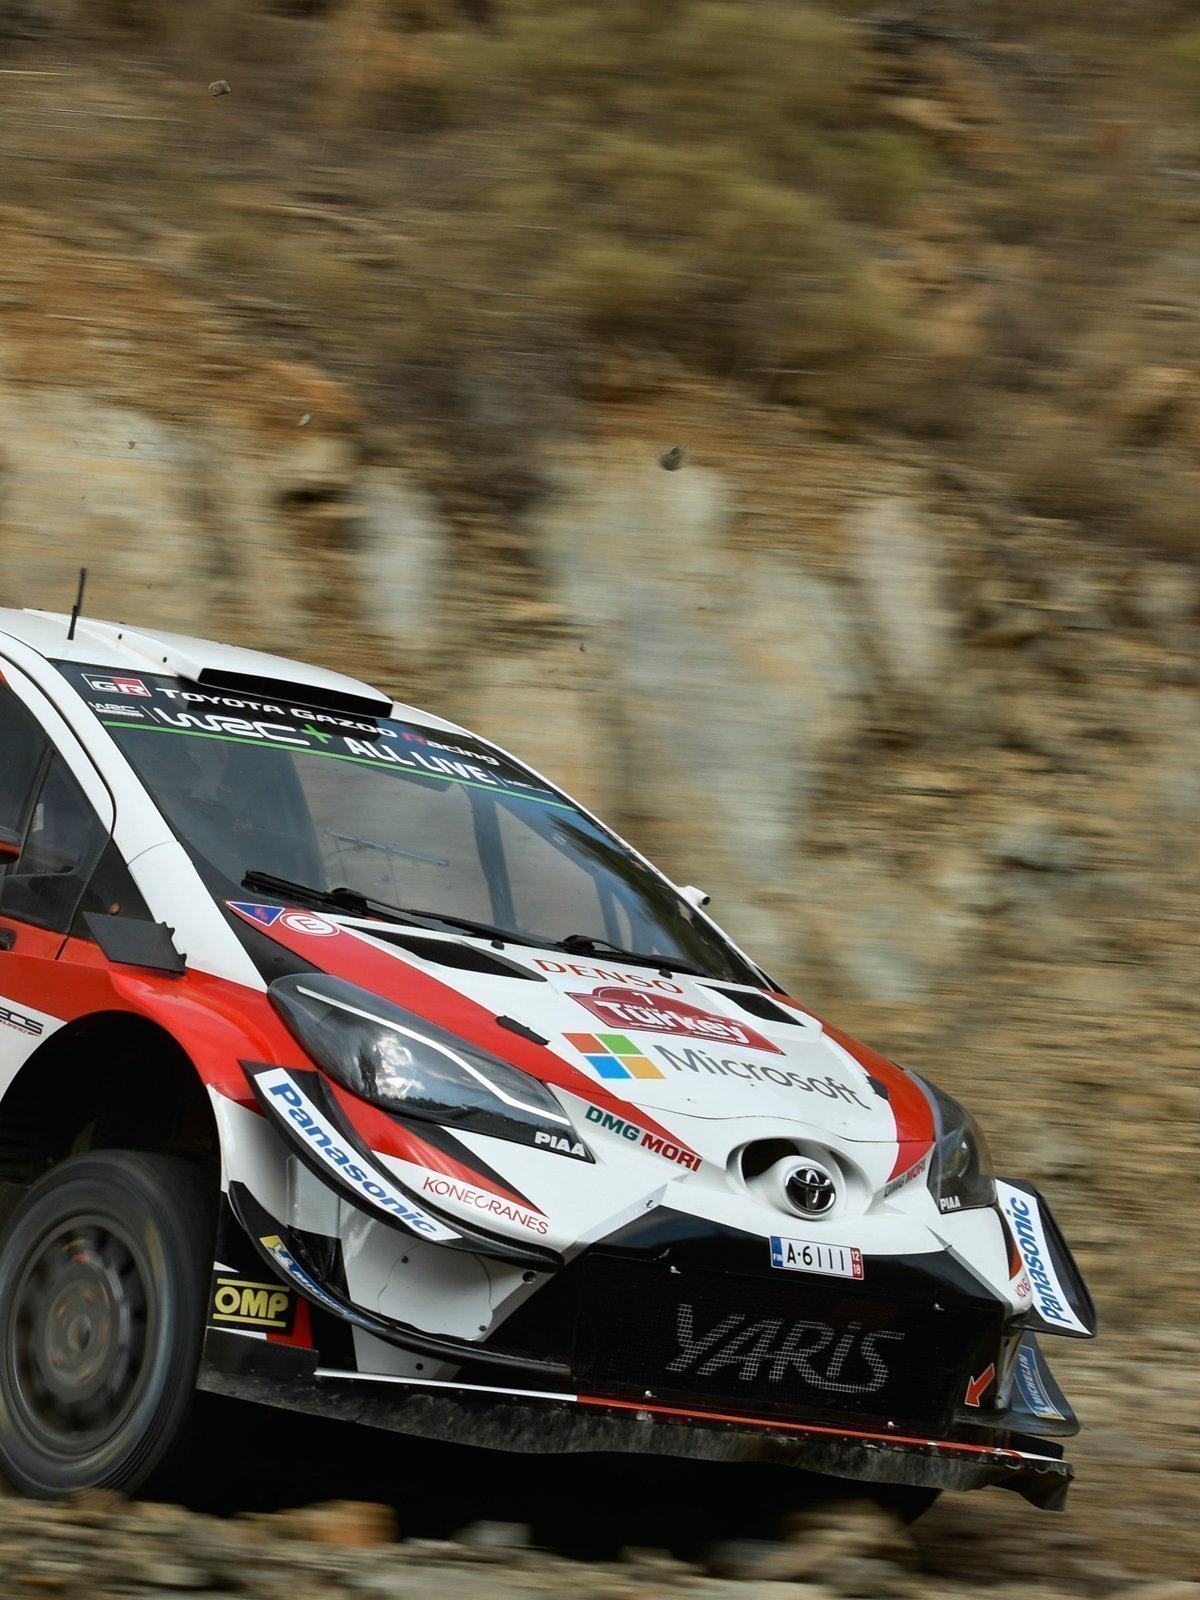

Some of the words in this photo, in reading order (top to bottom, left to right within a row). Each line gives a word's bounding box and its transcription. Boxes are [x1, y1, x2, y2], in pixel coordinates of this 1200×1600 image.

[91, 680, 147, 695] GR
[155, 687, 285, 715] TOYOTA
[290, 707, 398, 738] GAZOO
[402, 732, 500, 766] Racing
[343, 736, 416, 766] ALL
[410, 751, 498, 785] LIVE
[532, 958, 683, 994] DENSO
[653, 1044, 872, 1111] Microsoft
[268, 1083, 437, 1235] Panasonic
[535, 1131, 586, 1157] PIAA
[585, 1105, 640, 1141] DMG
[640, 1134, 703, 1173] MORI
[422, 1176, 549, 1236] KONECRANES
[939, 1196, 961, 1211] PIAA
[852, 1250, 860, 1261] 12
[1005, 1197, 1074, 1325] Panasonic
[214, 1284, 289, 1319] OMP
